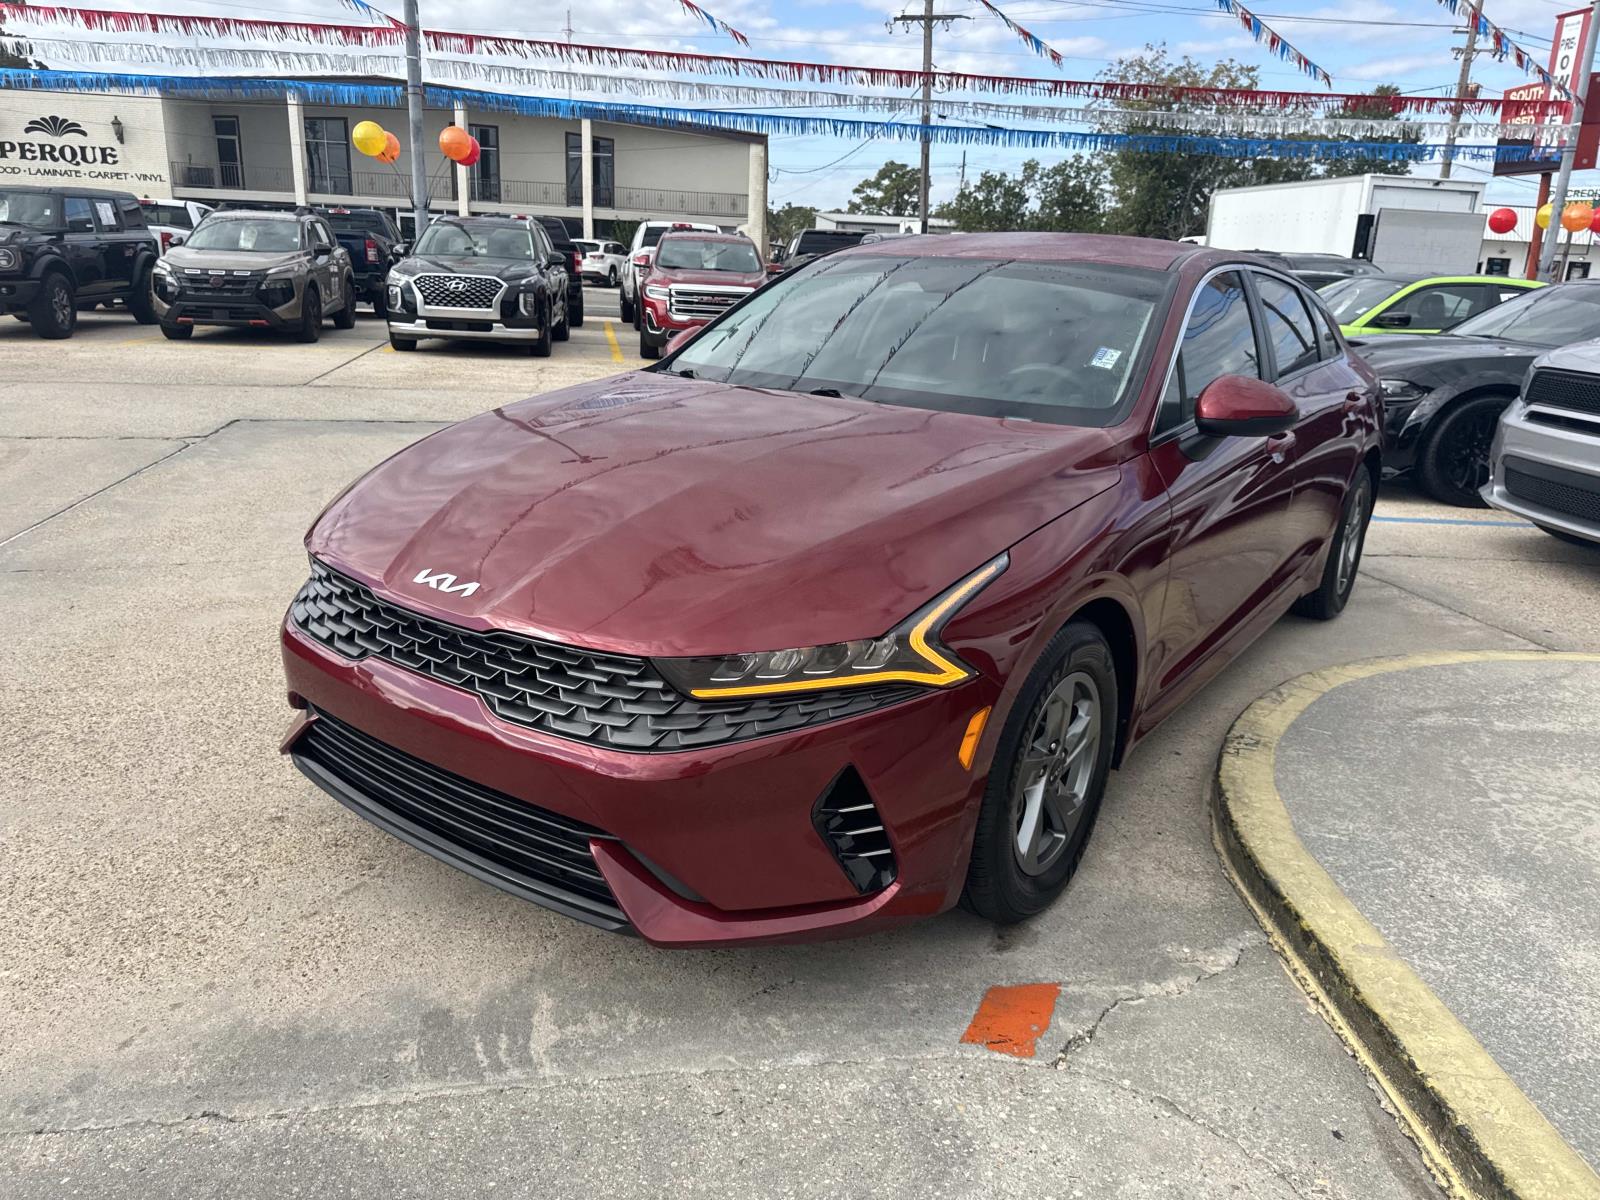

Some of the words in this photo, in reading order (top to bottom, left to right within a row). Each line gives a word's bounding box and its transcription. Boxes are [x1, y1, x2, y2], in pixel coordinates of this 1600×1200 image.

[0, 141, 119, 166] PERQUE
[28, 168, 82, 178] LAMINATE
[88, 170, 129, 181] CARPET
[134, 173, 167, 183] VINYL
[1562, 188, 1600, 199] CREDI
